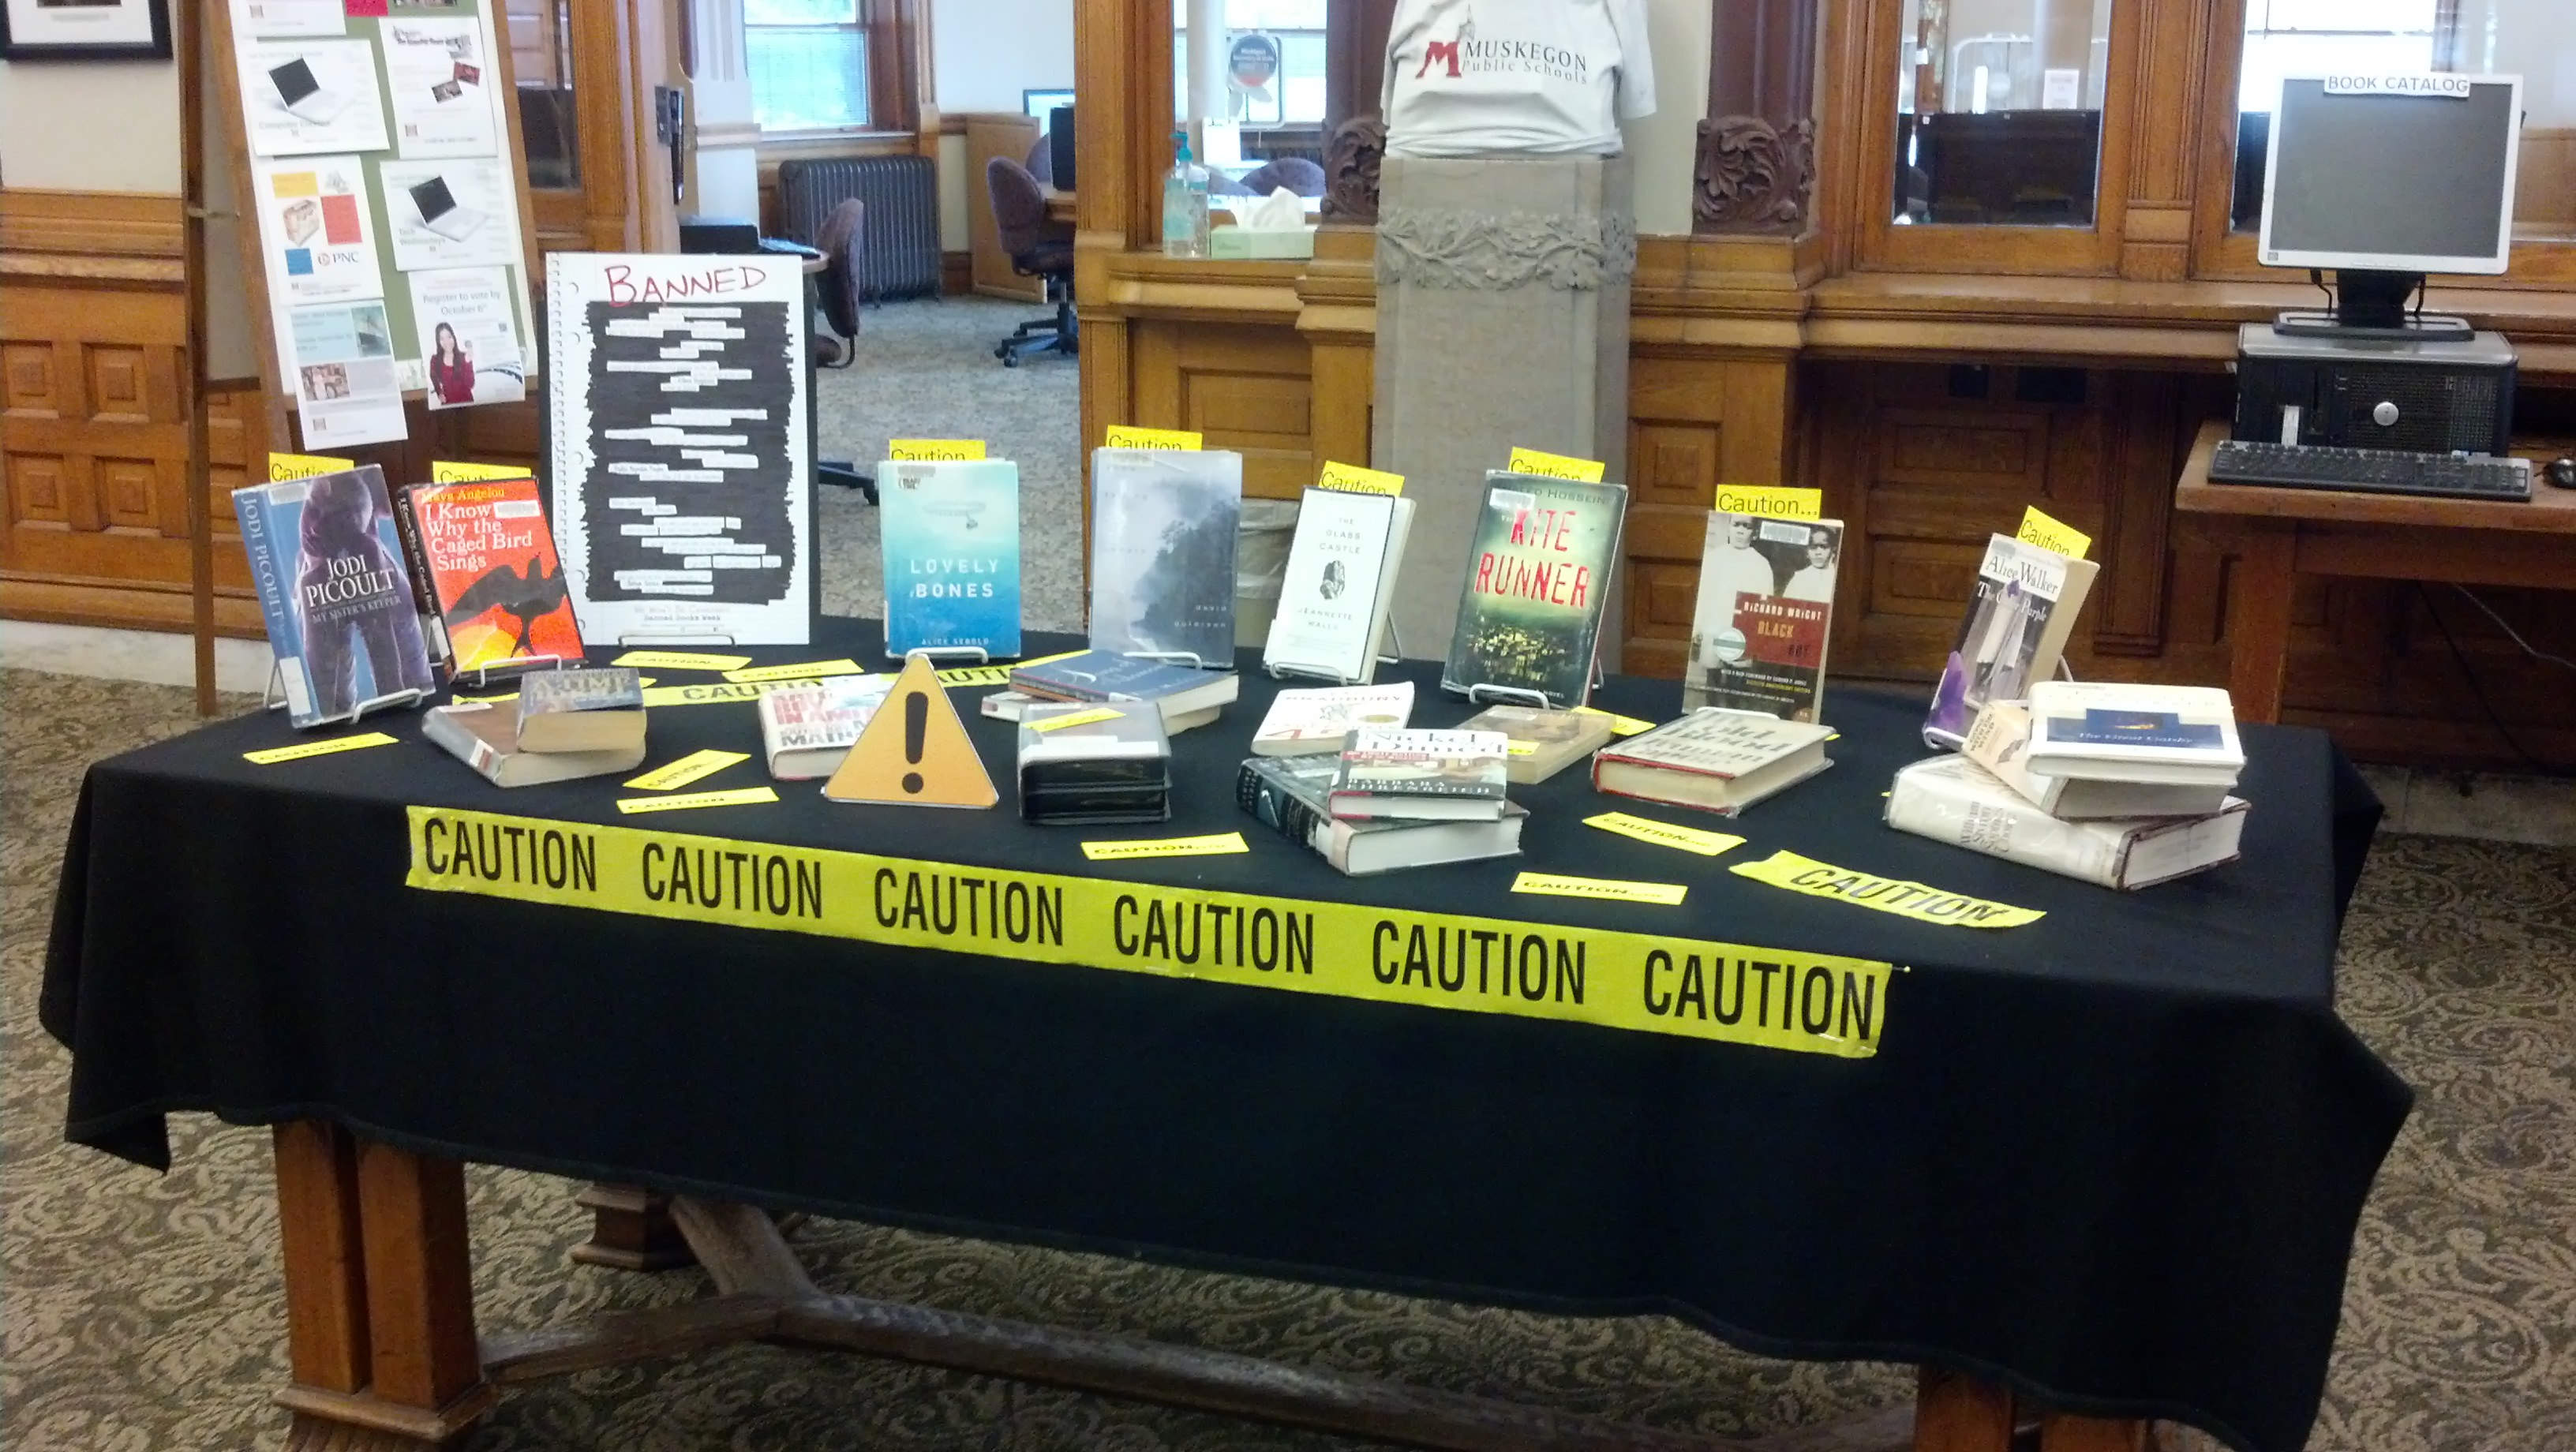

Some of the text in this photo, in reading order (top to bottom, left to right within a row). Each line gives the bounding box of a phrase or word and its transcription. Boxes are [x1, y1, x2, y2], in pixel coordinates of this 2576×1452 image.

[1465, 41, 1587, 72] MUSKEGON
[1462, 58, 1587, 84] Public Schools
[2327, 76, 2469, 93] BOOK CATALOG
[332, 252, 360, 264] PNC
[422, 293, 458, 305] Register
[490, 290, 500, 300] by
[605, 265, 767, 308] BANNED
[441, 305, 474, 315] October
[1321, 471, 1387, 495] Caution
[458, 488, 505, 502] Angelou
[425, 503, 492, 521] I Know
[427, 518, 503, 538] Why the
[1326, 530, 1361, 540] GLASS
[1511, 508, 1577, 552] KITE
[2020, 519, 2070, 556] Caution
[431, 530, 534, 556] Caged Bird
[1319, 543, 1361, 554] CASTLE
[242, 497, 284, 618] JODI PICOULT
[326, 554, 368, 582] JODI
[436, 555, 488, 572] Sings
[910, 558, 1000, 574] LOVELY
[1474, 552, 1591, 608] RUNNER
[1986, 556, 2057, 594] Alice Walker
[305, 567, 395, 608] PICOULT
[915, 582, 994, 598] BONES
[1297, 607, 1354, 621] JEANNETTE
[2021, 599, 2046, 621] Purple
[1758, 620, 1795, 638] BLACK
[1789, 869, 2011, 922] CAUTION
[424, 818, 1877, 1042] CAUTION CAUTION CAUTION CAUTION CAUTION CAUTION
